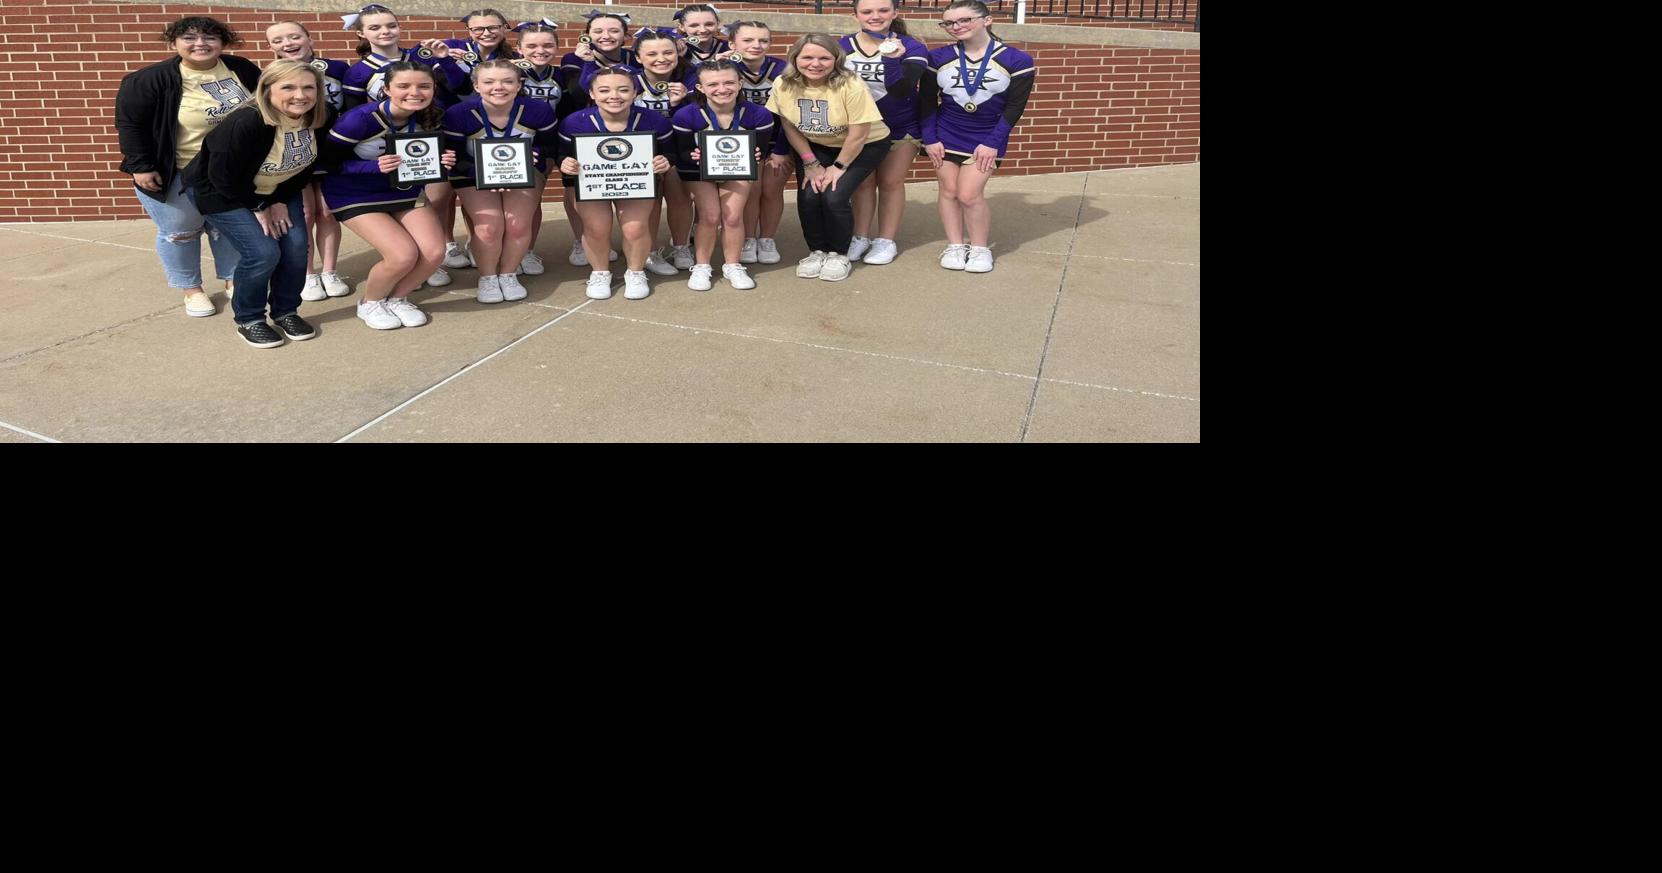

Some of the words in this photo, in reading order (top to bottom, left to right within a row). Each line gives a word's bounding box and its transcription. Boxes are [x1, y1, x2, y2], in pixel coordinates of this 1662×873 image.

[797, 98, 829, 128] H
[582, 163, 618, 171] GAME
[621, 162, 649, 170] DAY
[413, 169, 437, 177] PLACE
[585, 184, 603, 192] 1ST
[605, 182, 647, 191] PLACE
